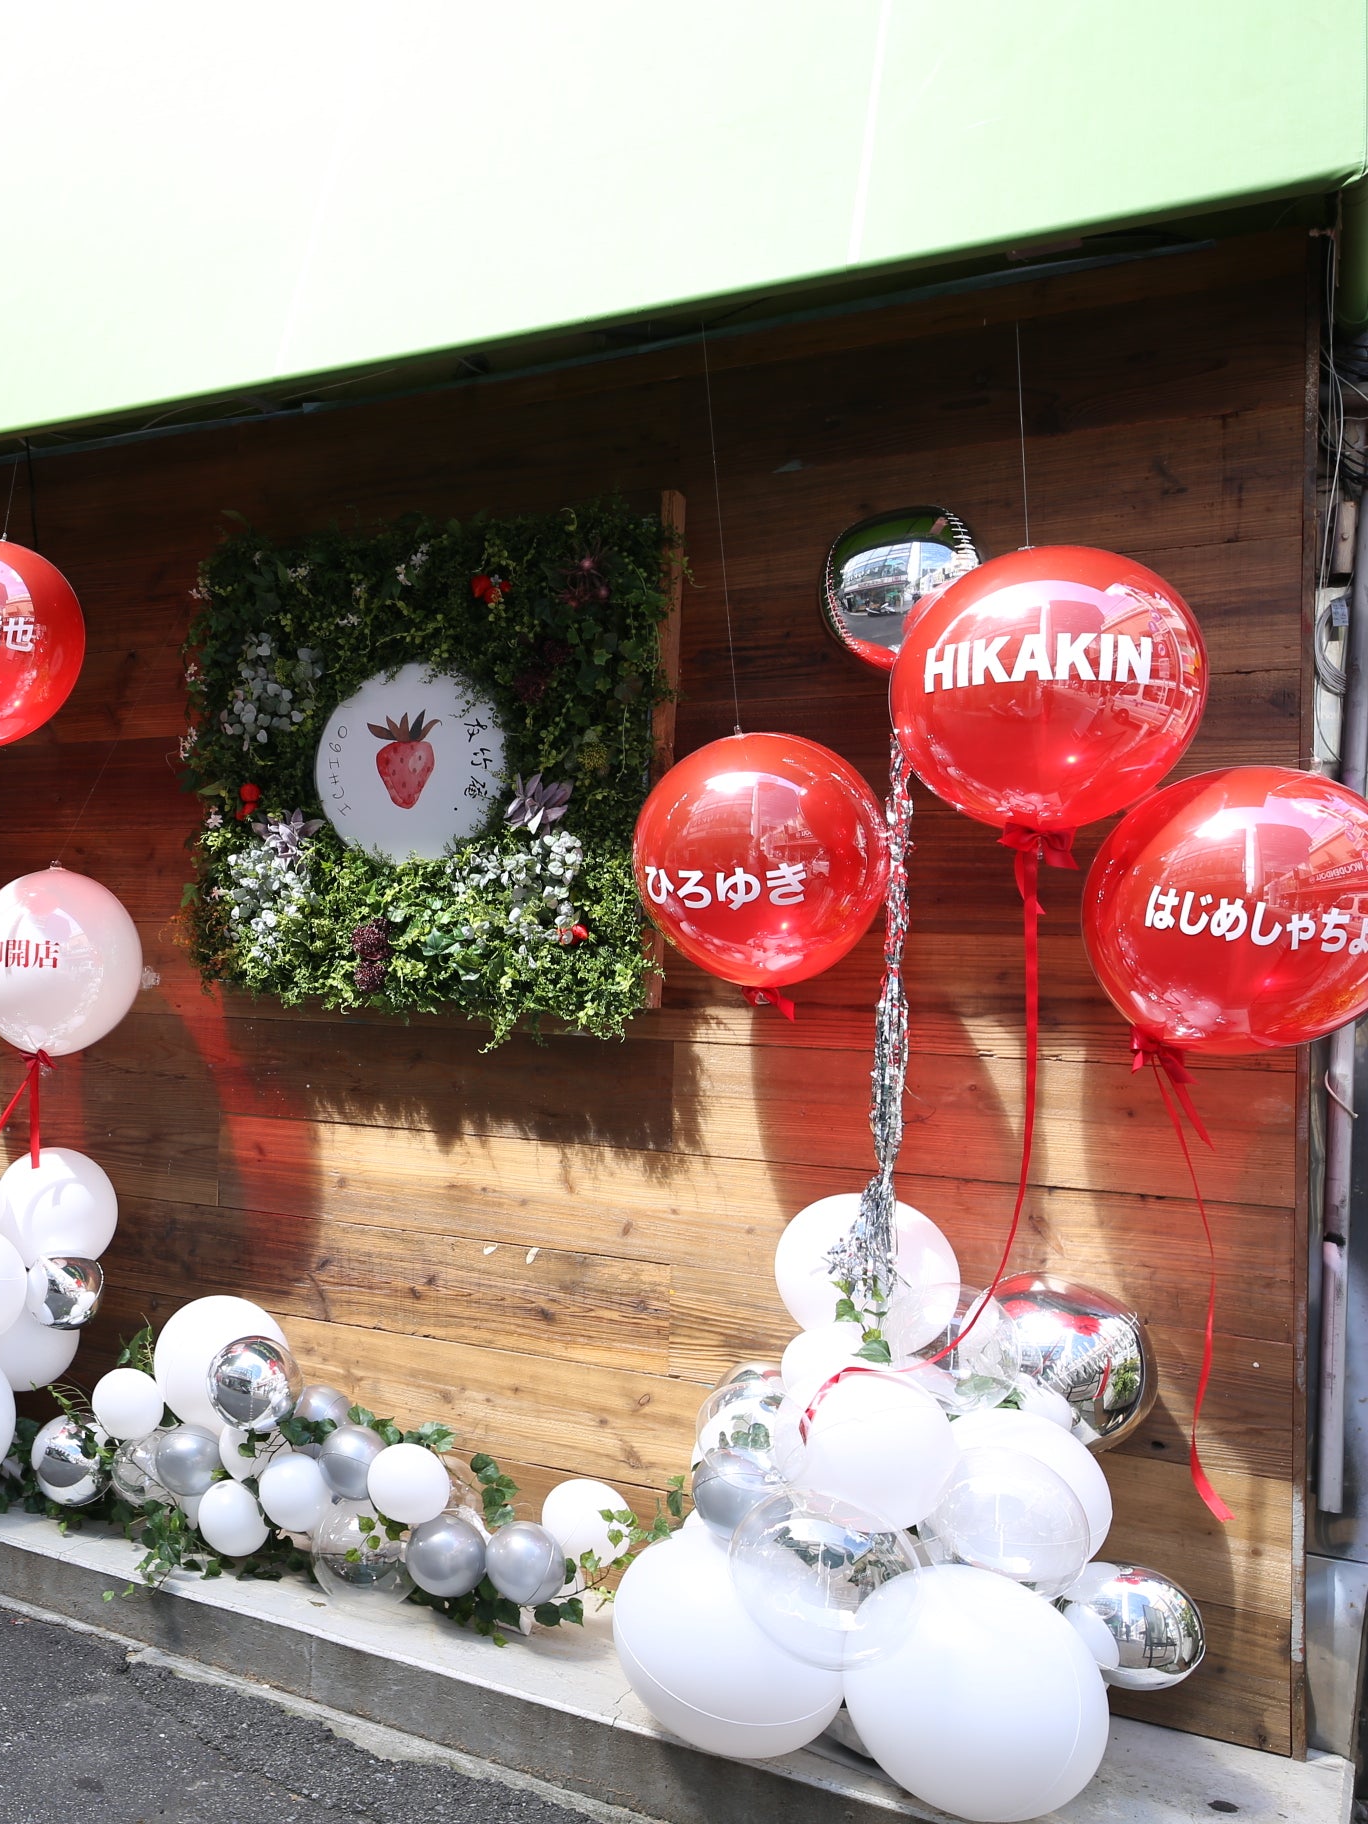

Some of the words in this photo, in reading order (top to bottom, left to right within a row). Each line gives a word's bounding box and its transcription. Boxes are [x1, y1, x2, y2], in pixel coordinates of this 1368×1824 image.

[923, 632, 1152, 694] HIKAKIN
[328, 725, 352, 817] ICHIGO
[644, 862, 807, 911] ひろゆき
